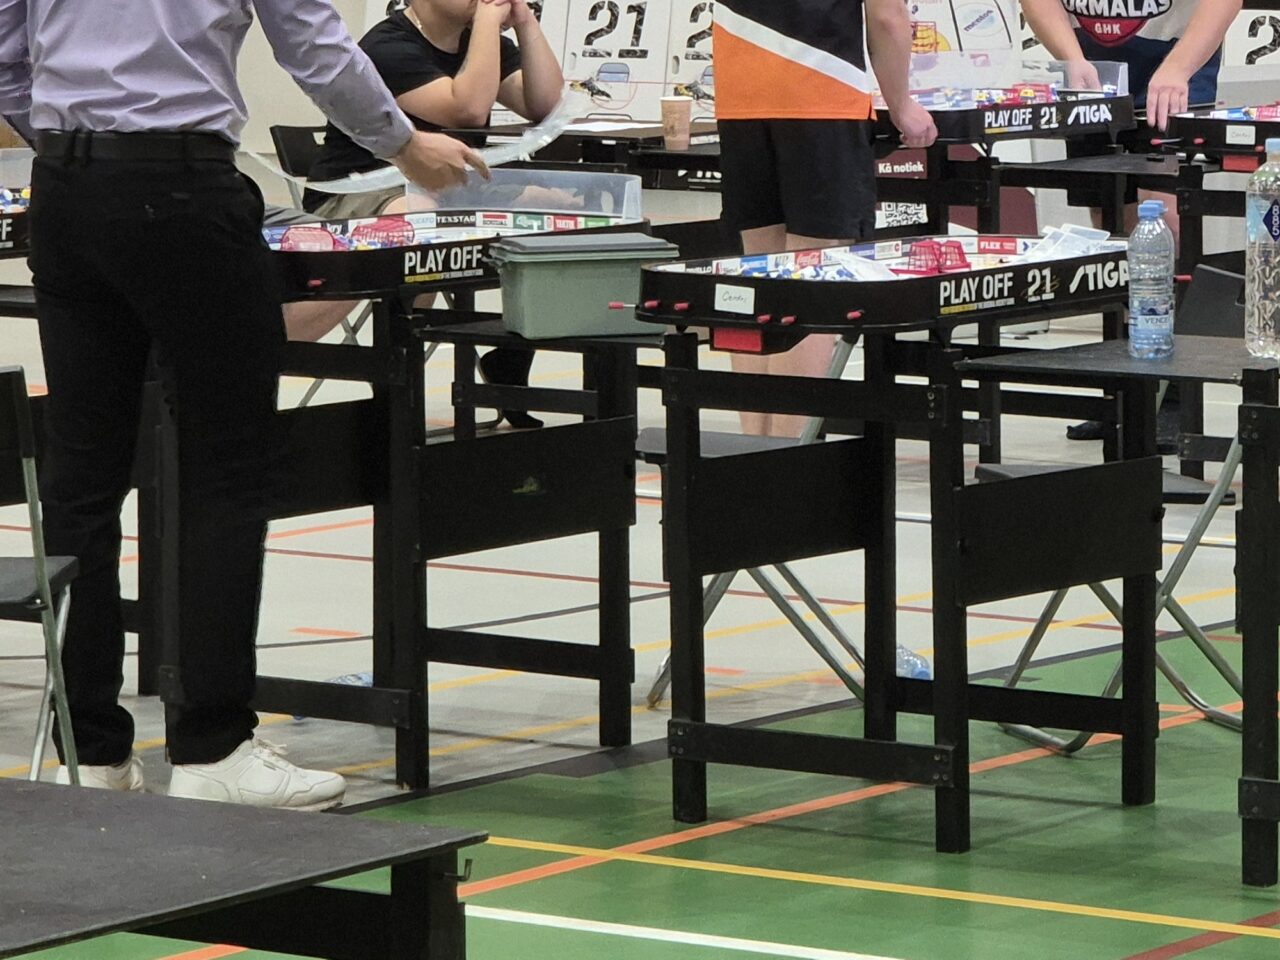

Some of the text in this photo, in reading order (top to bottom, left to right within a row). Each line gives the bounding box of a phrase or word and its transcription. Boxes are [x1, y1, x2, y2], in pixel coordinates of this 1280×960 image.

[584, 0, 648, 48] 21
[1094, 22, 1121, 35] GHK
[985, 103, 1113, 129] PLAY OFF 21 STIGA
[878, 161, 925, 174] Kā notiek
[1271, 205, 1280, 236] 885
[979, 241, 1001, 250] FLEX
[404, 245, 483, 275] PLAY OFF
[939, 260, 1130, 306] PLAY OFF 21 STIGA
